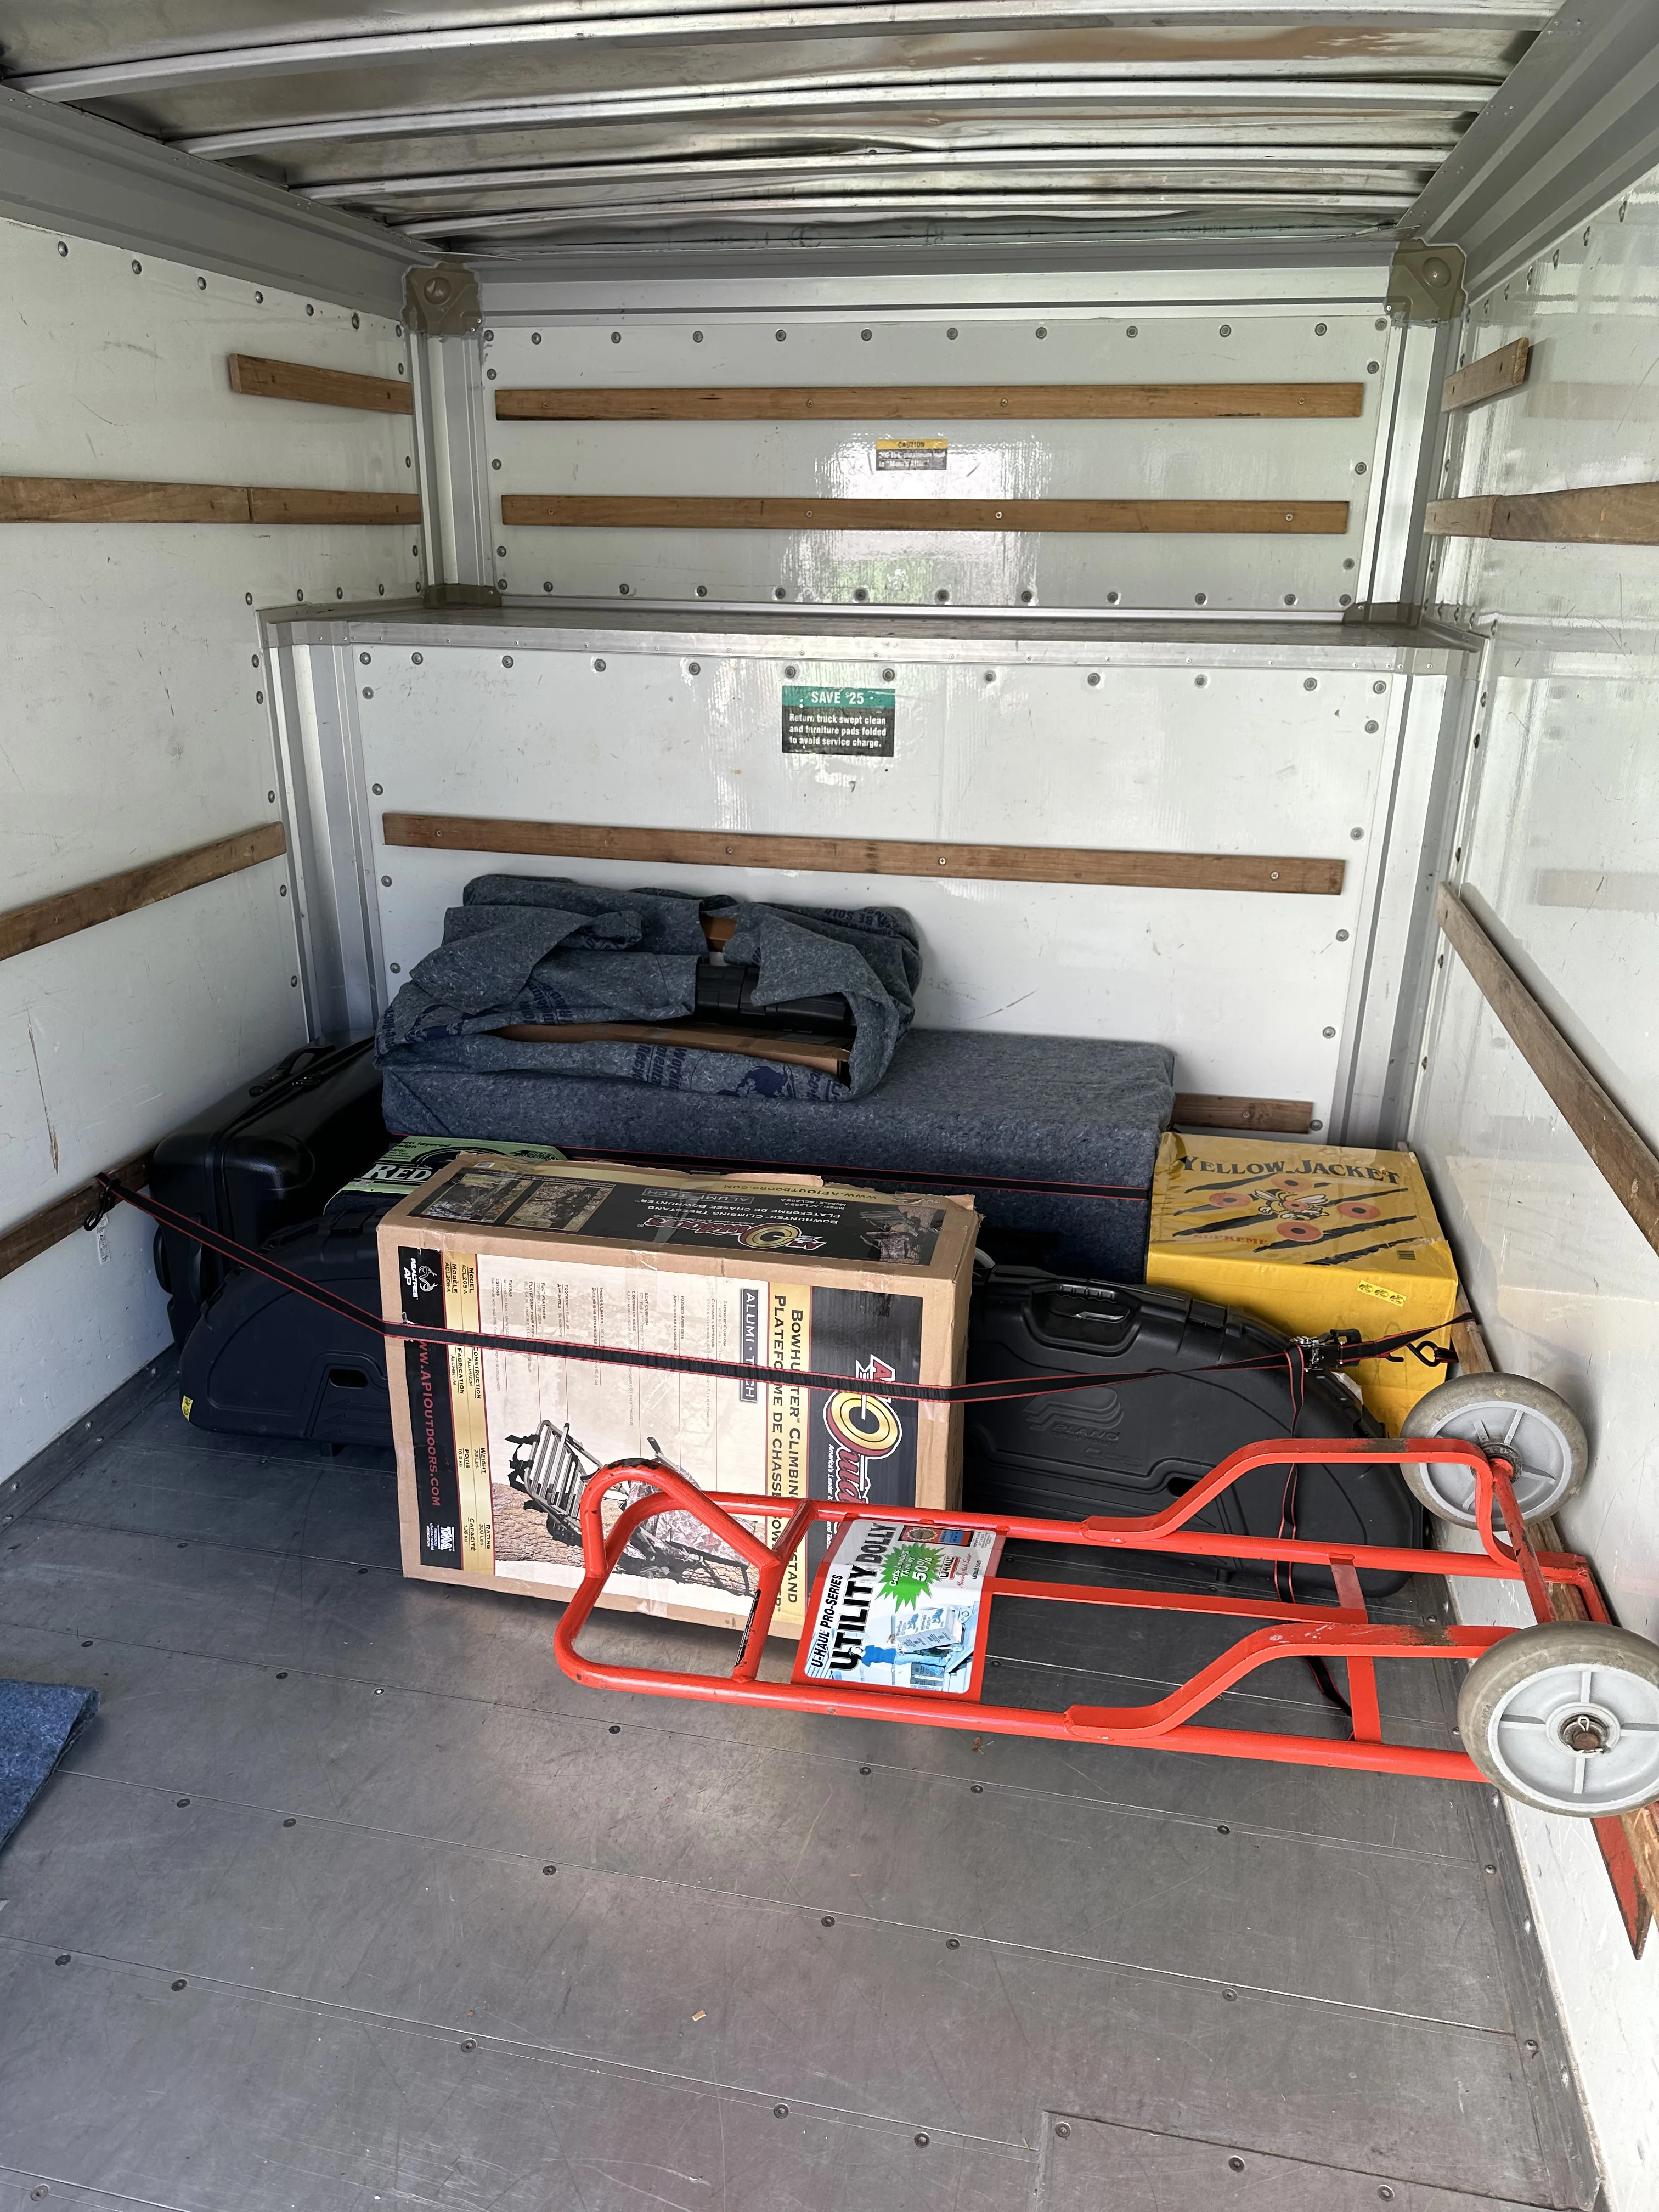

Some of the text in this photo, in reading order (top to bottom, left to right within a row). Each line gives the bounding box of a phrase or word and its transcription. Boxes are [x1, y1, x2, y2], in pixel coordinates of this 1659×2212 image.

[811, 691, 864, 704] SAVE $25
[789, 714, 886, 725] Return truck swept clean
[805, 726, 839, 734] furniture
[842, 727, 860, 736] pads
[862, 727, 886, 736] folded
[799, 737, 820, 745] avoid
[853, 738, 881, 748] charge.
[1182, 1157, 1400, 1184] YELLOW JACKET
[646, 1190, 686, 1198] TECH
[724, 1184, 876, 1200] WWW.APIOUTDOORS.COM
[640, 1199, 707, 1209] BOWHUNTER
[648, 1206, 708, 1215] TREESTAND
[769, 1215, 838, 1224] BOWHUNTER
[771, 1210, 841, 1218] PLATEFORME
[1193, 1234, 1268, 1245] SUPREME
[404, 1267, 411, 1285] AP
[744, 1291, 755, 1398] ALUMI TCH
[772, 1295, 786, 1406] PLATEFOME
[789, 1310, 803, 1417] BOWHUTER
[419, 1341, 441, 1507] WW.APIOUTDOORS.COM
[772, 1413, 782, 1433] DE
[1052, 1423, 1120, 1441] PLANO
[788, 1428, 801, 1498] CLIMBIN
[889, 1550, 909, 1587] Cuts Loading
[912, 1557, 932, 1582] 50%
[940, 1556, 955, 1578] U-HAUL
[972, 1560, 981, 1579] uhaul.com
[828, 1522, 898, 1671] UTILITY DOLLY
[811, 1575, 843, 1668] U-HAUL PRO-SERIES
